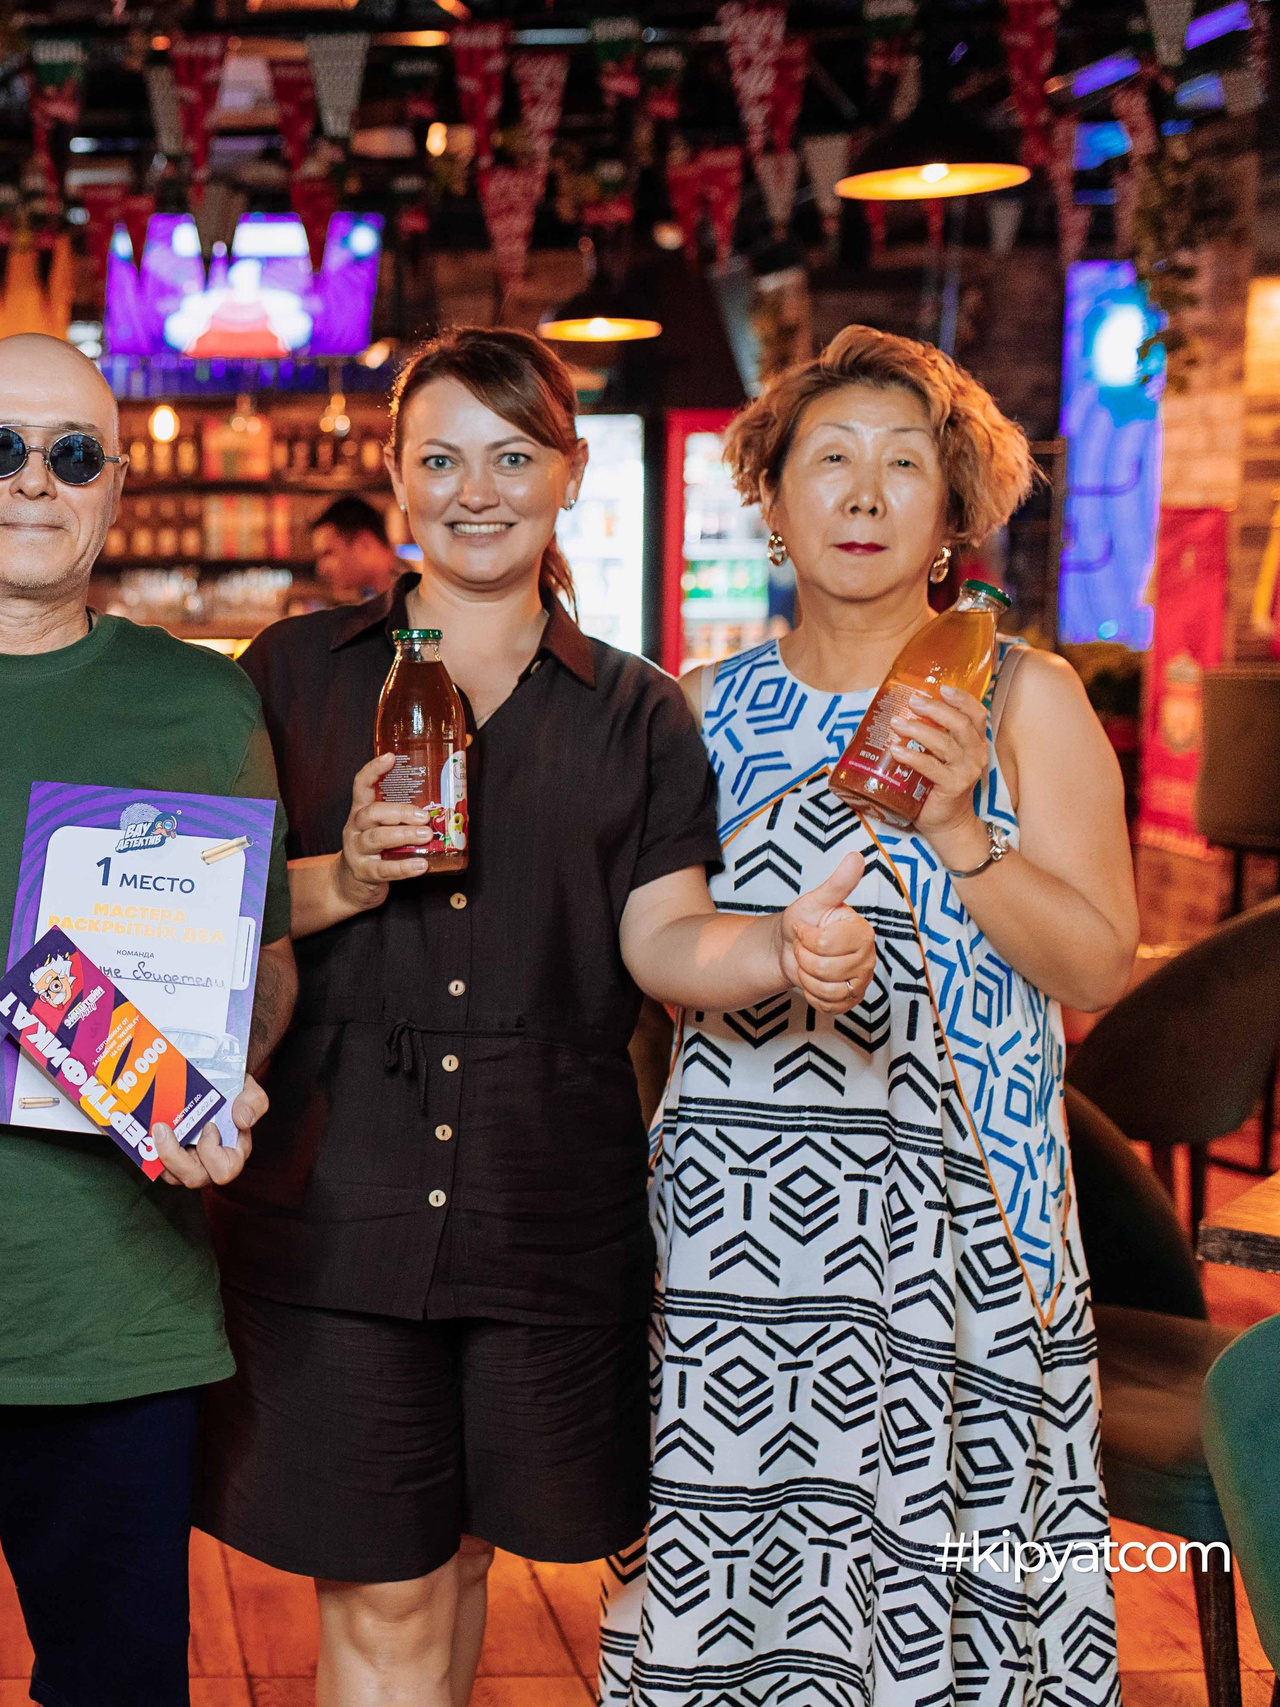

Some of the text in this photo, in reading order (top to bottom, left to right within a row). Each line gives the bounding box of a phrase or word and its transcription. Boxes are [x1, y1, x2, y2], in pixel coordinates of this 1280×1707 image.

[124, 822, 152, 838] ВАУ
[116, 835, 162, 851] ДЕТЕКТИВ
[96, 856, 195, 894] 1 МЕСТО
[93, 902, 187, 924] МАСТЕРА
[47, 915, 225, 945] РАСКРЫТЫХ ДЕЛ
[116, 950, 155, 959] КОМАНДА
[116, 1037, 168, 1094] 10 000
